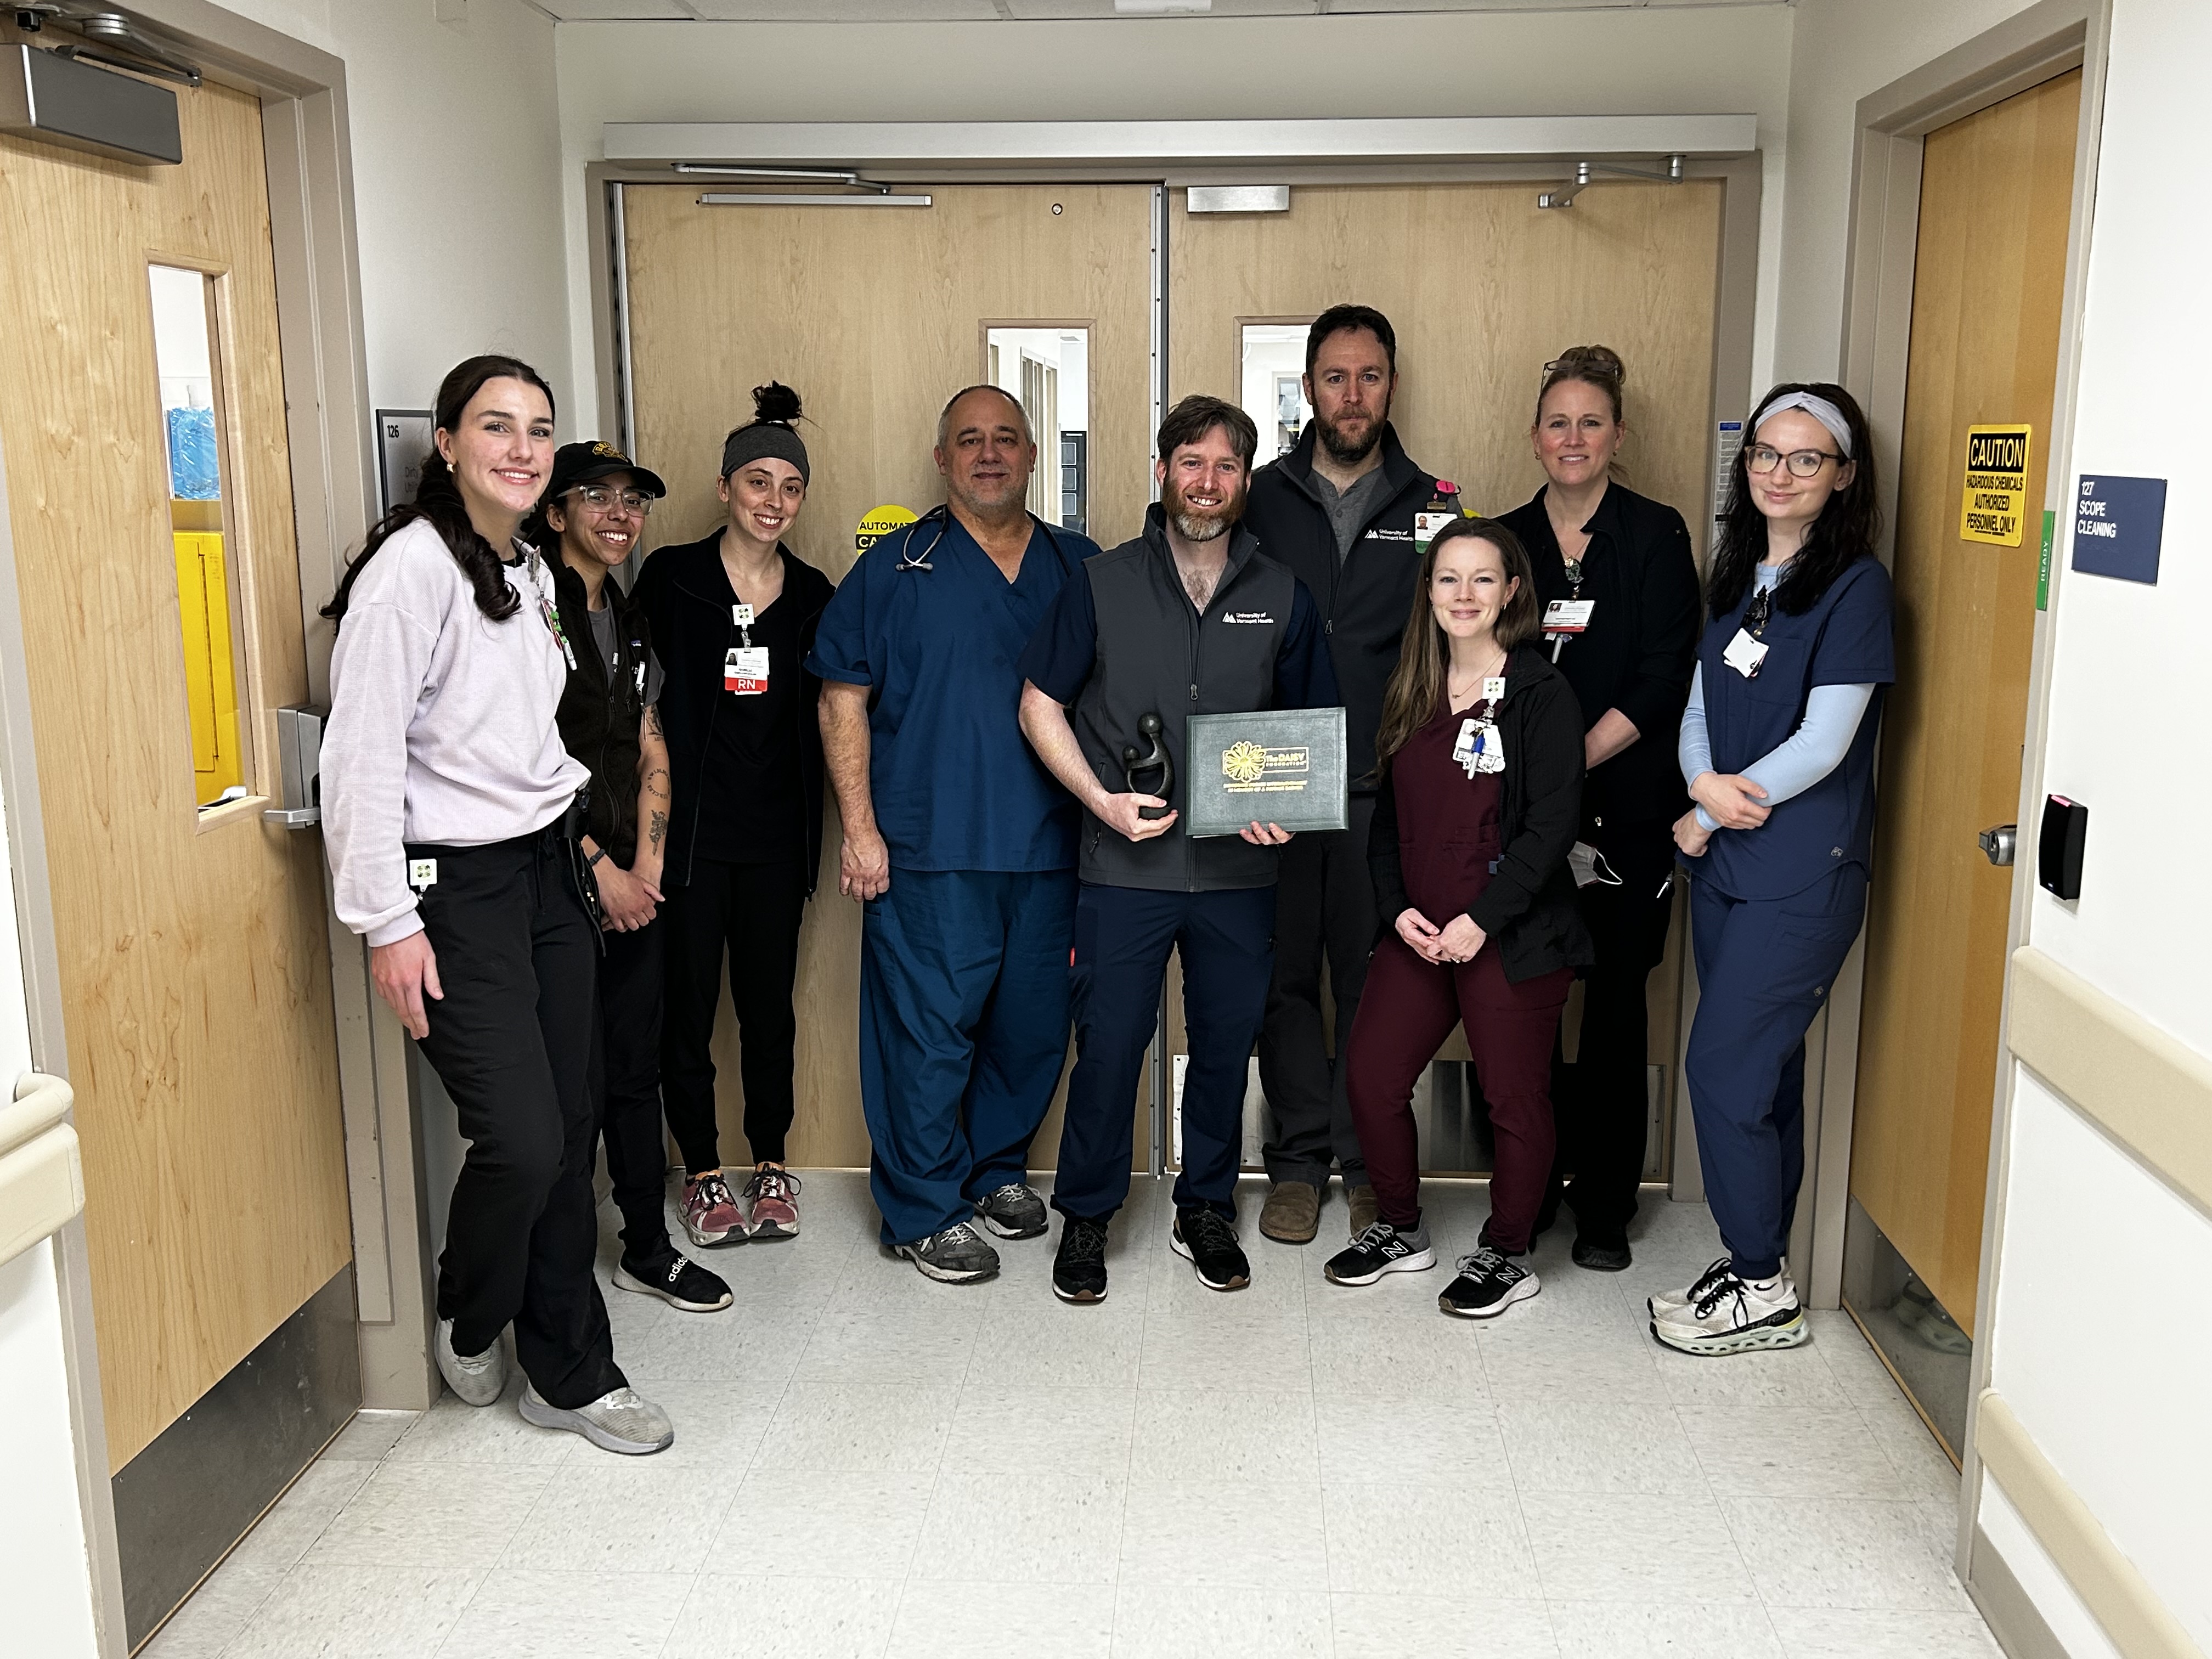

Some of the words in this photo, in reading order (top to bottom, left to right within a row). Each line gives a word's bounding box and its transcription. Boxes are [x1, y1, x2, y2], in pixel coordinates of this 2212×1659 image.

[387, 425, 399, 438] 126
[1970, 438, 2024, 467] CAUTION
[1966, 475, 1994, 489] HAZARDOUS
[1995, 476, 2023, 491] CHEMICALS
[2081, 481, 2095, 495] 127
[1974, 493, 2010, 511] AUTHORIZED
[2079, 500, 2107, 517] SCOPE
[859, 522, 912, 530] AUTOMA
[1966, 512, 1999, 531] PERSONNEL
[1999, 516, 2016, 533] ONLY
[2077, 519, 2117, 538] CLEANING
[858, 536, 881, 548] CA
[2040, 541, 2049, 582] READY
[738, 679, 755, 690] RN
[1278, 753, 1305, 761] DAISY
